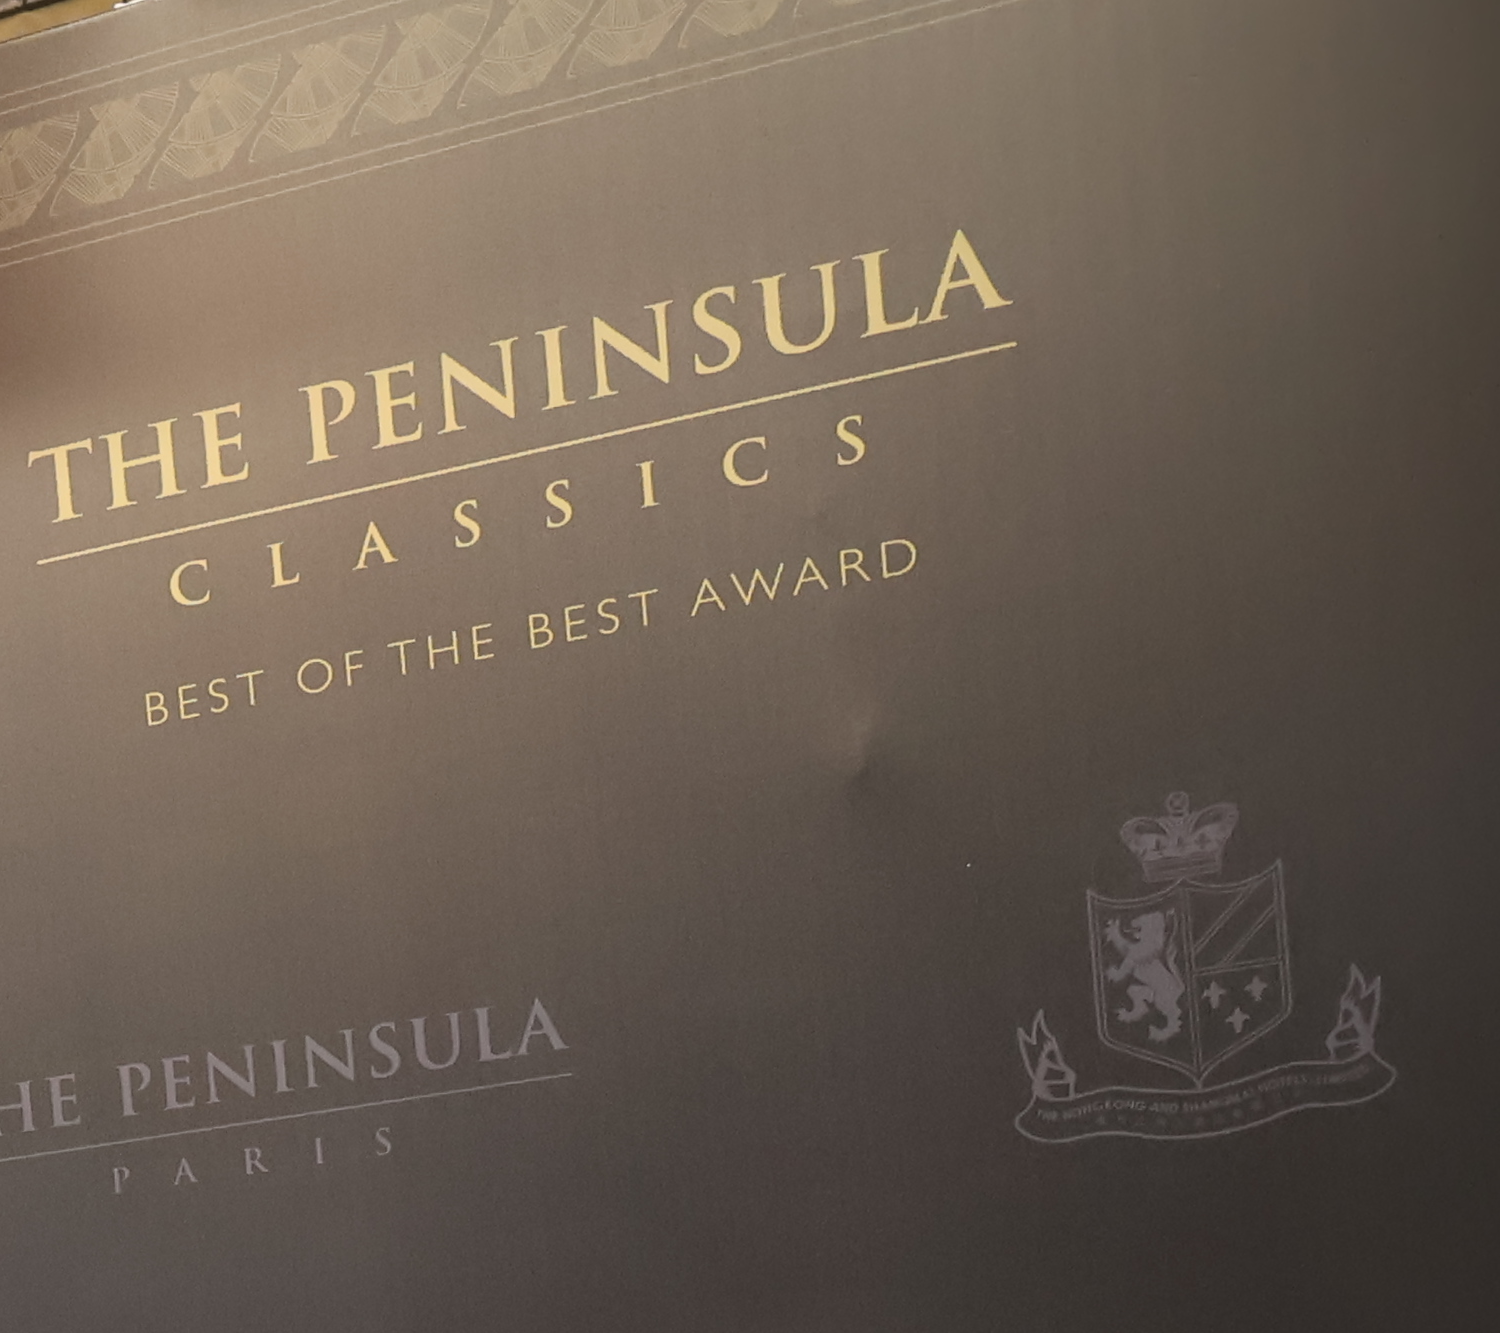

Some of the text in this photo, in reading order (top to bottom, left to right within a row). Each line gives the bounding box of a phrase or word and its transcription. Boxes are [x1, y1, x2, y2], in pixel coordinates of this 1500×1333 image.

[28, 228, 1014, 523] THE PENINSULA
[168, 414, 867, 606] CLASSICS
[144, 538, 918, 726] BEST OF THE BEST AWARD
[115, 996, 570, 1119] PENINSULA
[111, 1125, 393, 1196] PARIS
